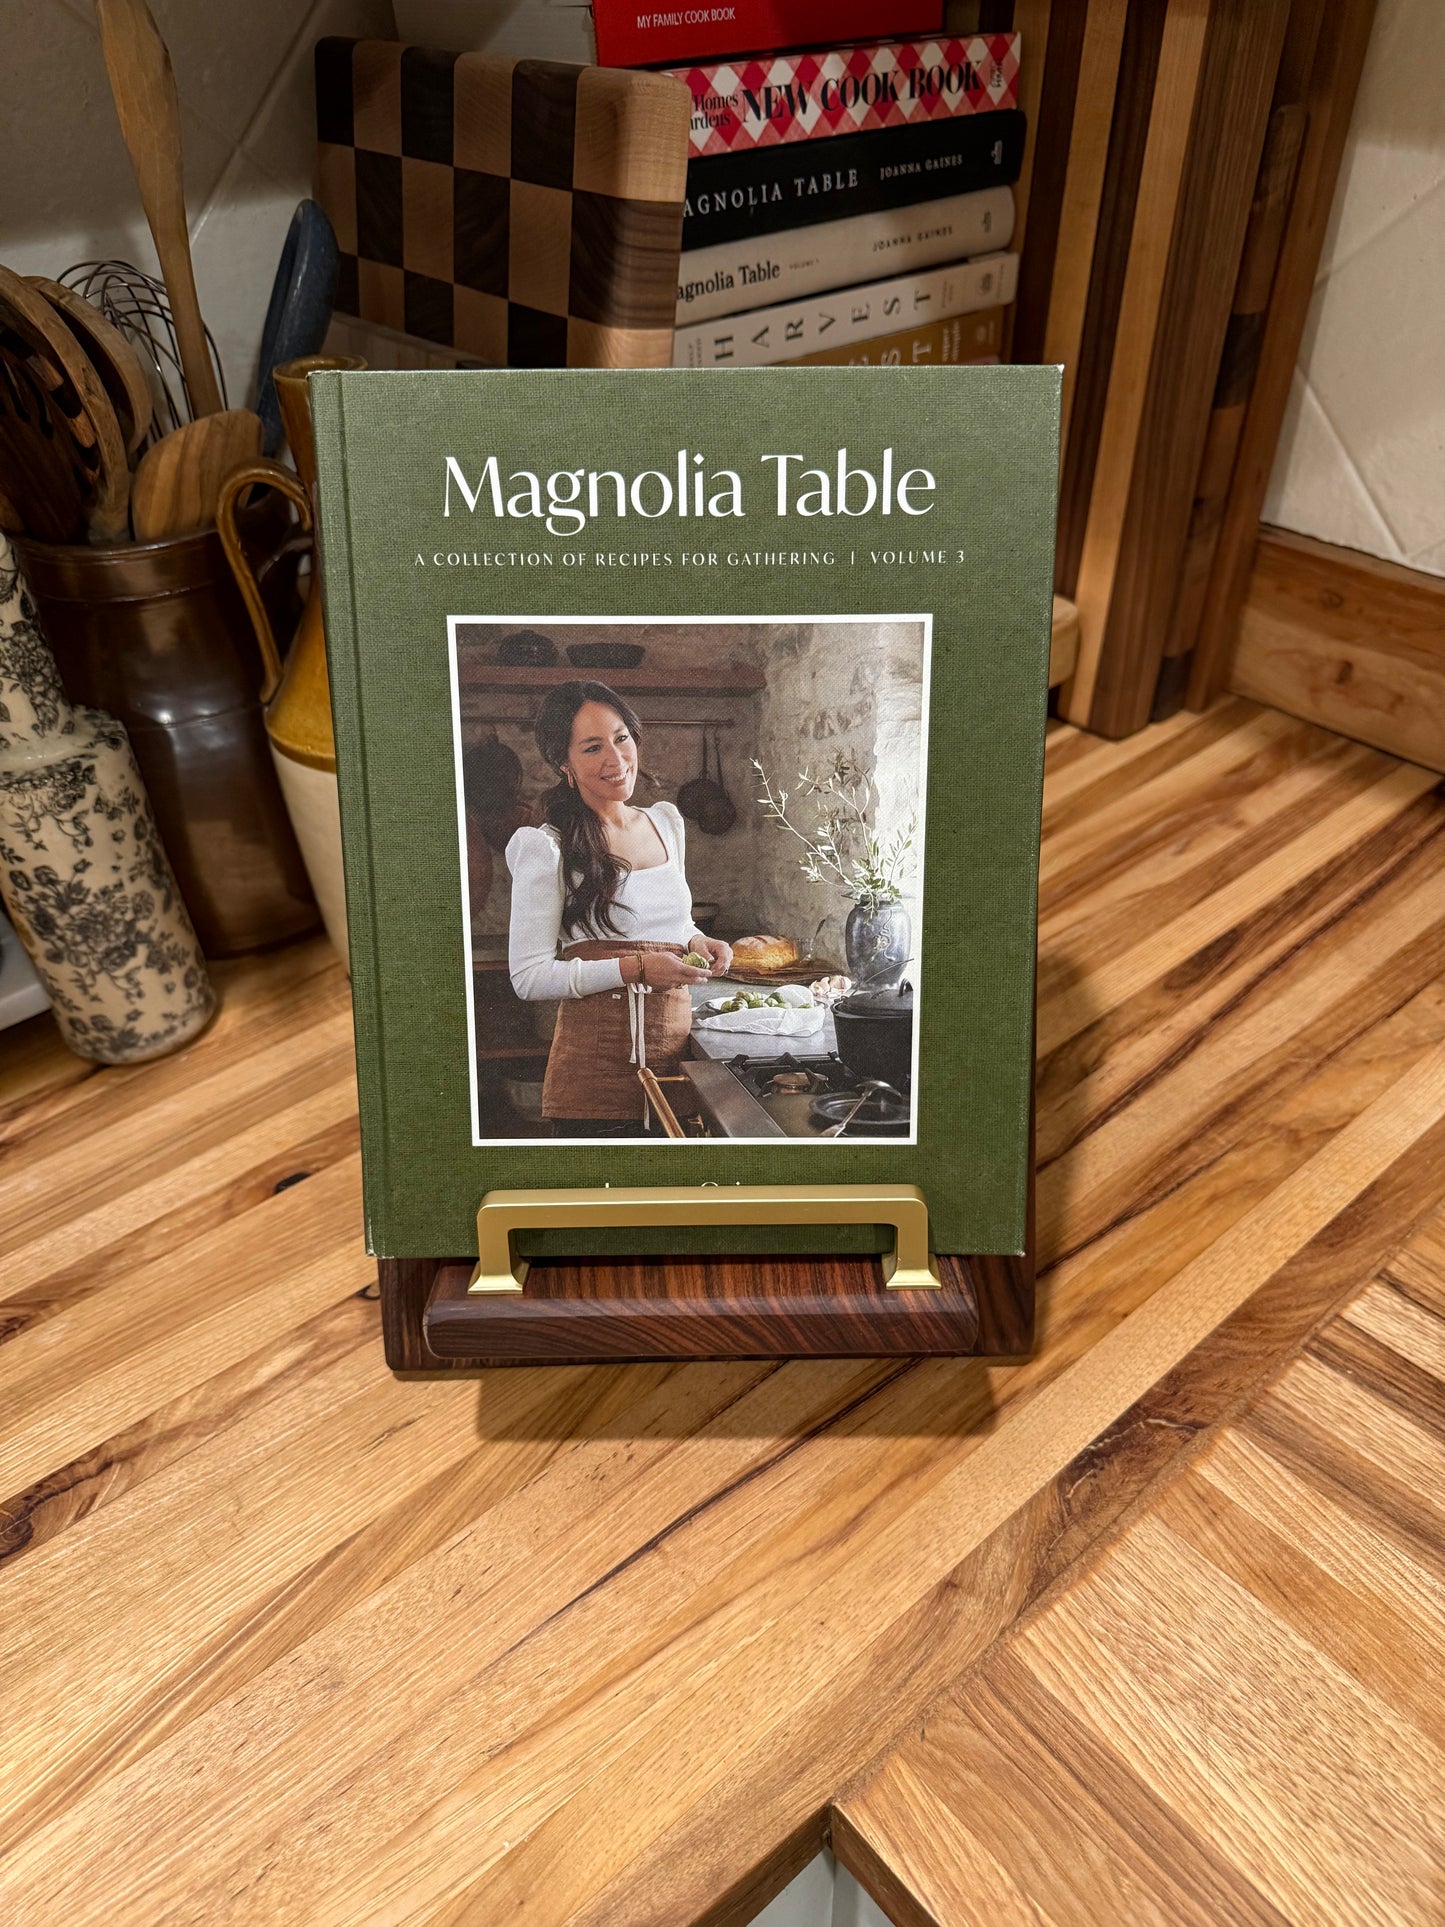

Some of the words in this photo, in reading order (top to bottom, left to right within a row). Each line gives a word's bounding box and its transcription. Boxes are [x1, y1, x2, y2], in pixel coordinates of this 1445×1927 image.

[637, 15, 651, 29] MY
[653, 12, 683, 27] FAMILY
[684, 10, 710, 24] COOK
[711, 7, 736, 21] BOOK
[694, 94, 739, 112] Homes
[742, 82, 810, 122] NEW
[821, 71, 900, 111] COOK
[909, 61, 981, 99] BOOK
[880, 163, 921, 180] JOANNA
[924, 154, 963, 171] GAINES
[683, 182, 783, 217] AGNOLIA
[794, 168, 858, 197] TABLE
[872, 235, 913, 252] JOANNA
[677, 271, 735, 302] agnolia
[738, 260, 781, 287] Table
[714, 289, 931, 361] HARVEST
[443, 449, 746, 537] Magnolia
[761, 447, 937, 517] Table
[415, 554, 427, 567] A
[433, 552, 554, 567] COLLECTION
[559, 552, 588, 567] OF
[595, 552, 673, 567] RECIPES
[682, 552, 720, 567] FOR
[727, 551, 836, 567] GATHERING
[870, 550, 950, 565] VOLUME
[956, 550, 966, 565] 3
